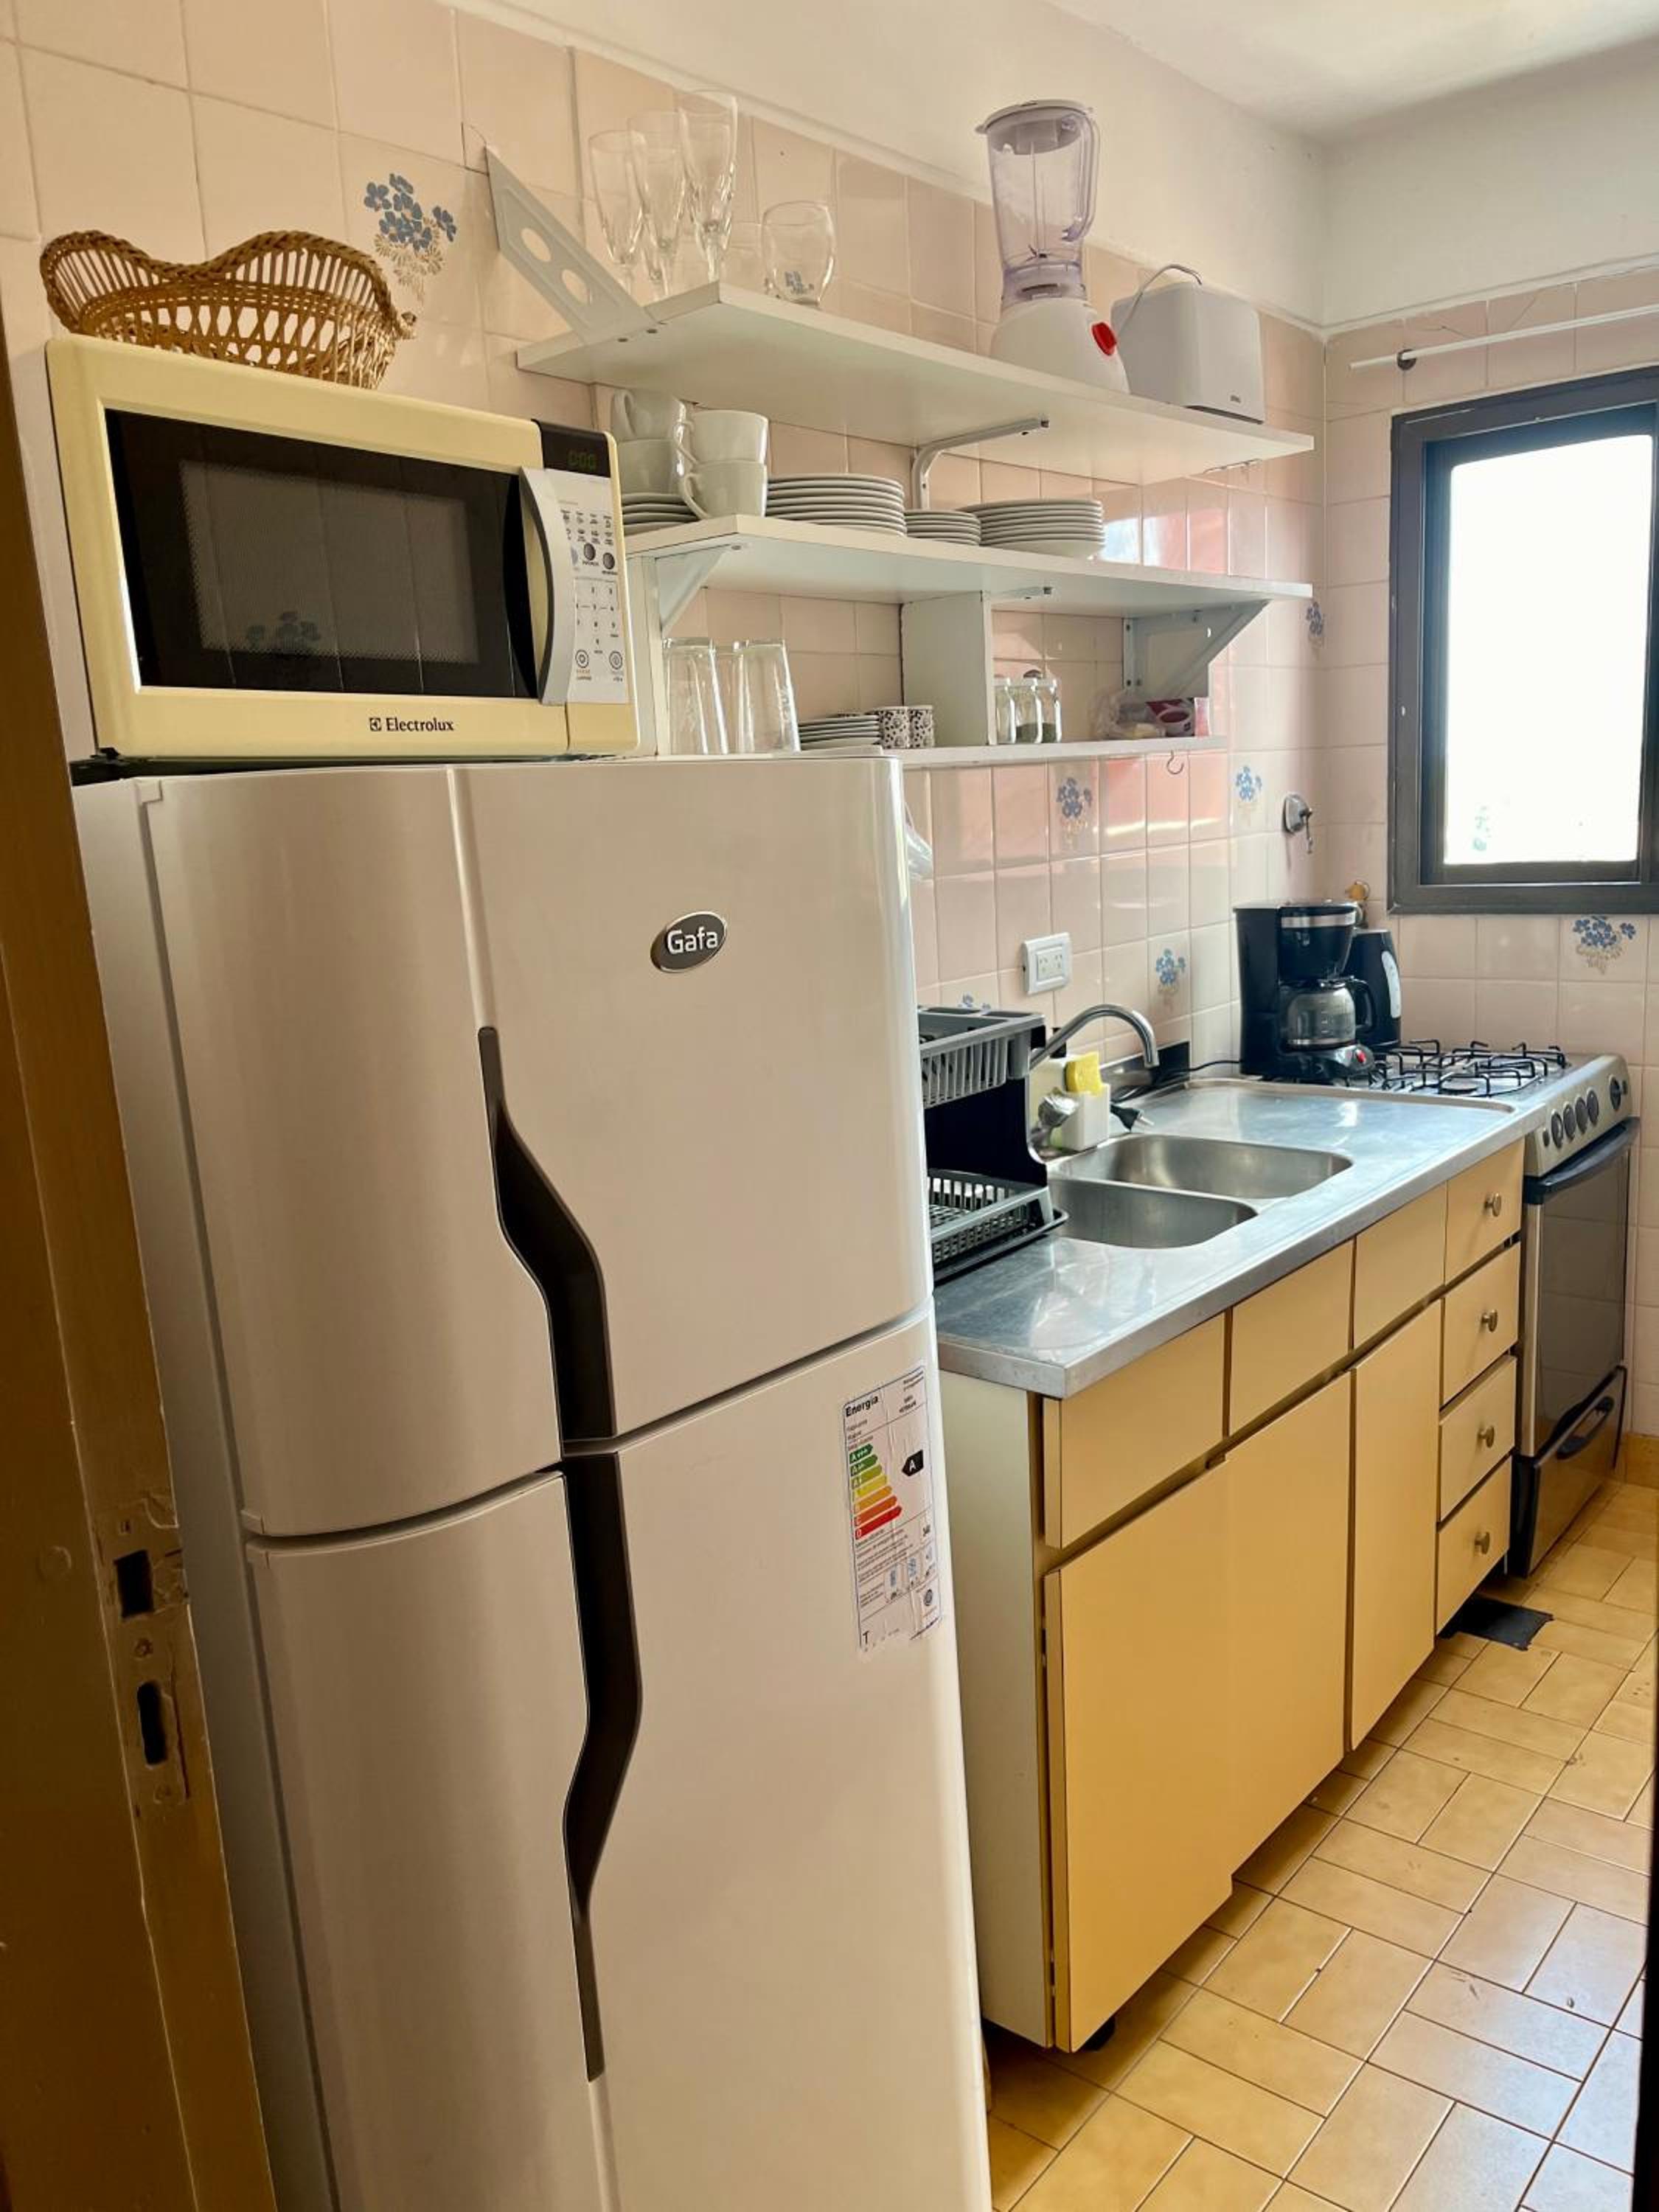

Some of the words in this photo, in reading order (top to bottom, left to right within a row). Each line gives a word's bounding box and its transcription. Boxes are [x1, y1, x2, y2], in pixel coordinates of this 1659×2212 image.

[386, 717, 454, 731] Electrolux
[667, 926, 717, 954] Gafa
[909, 1459, 917, 1472] A
